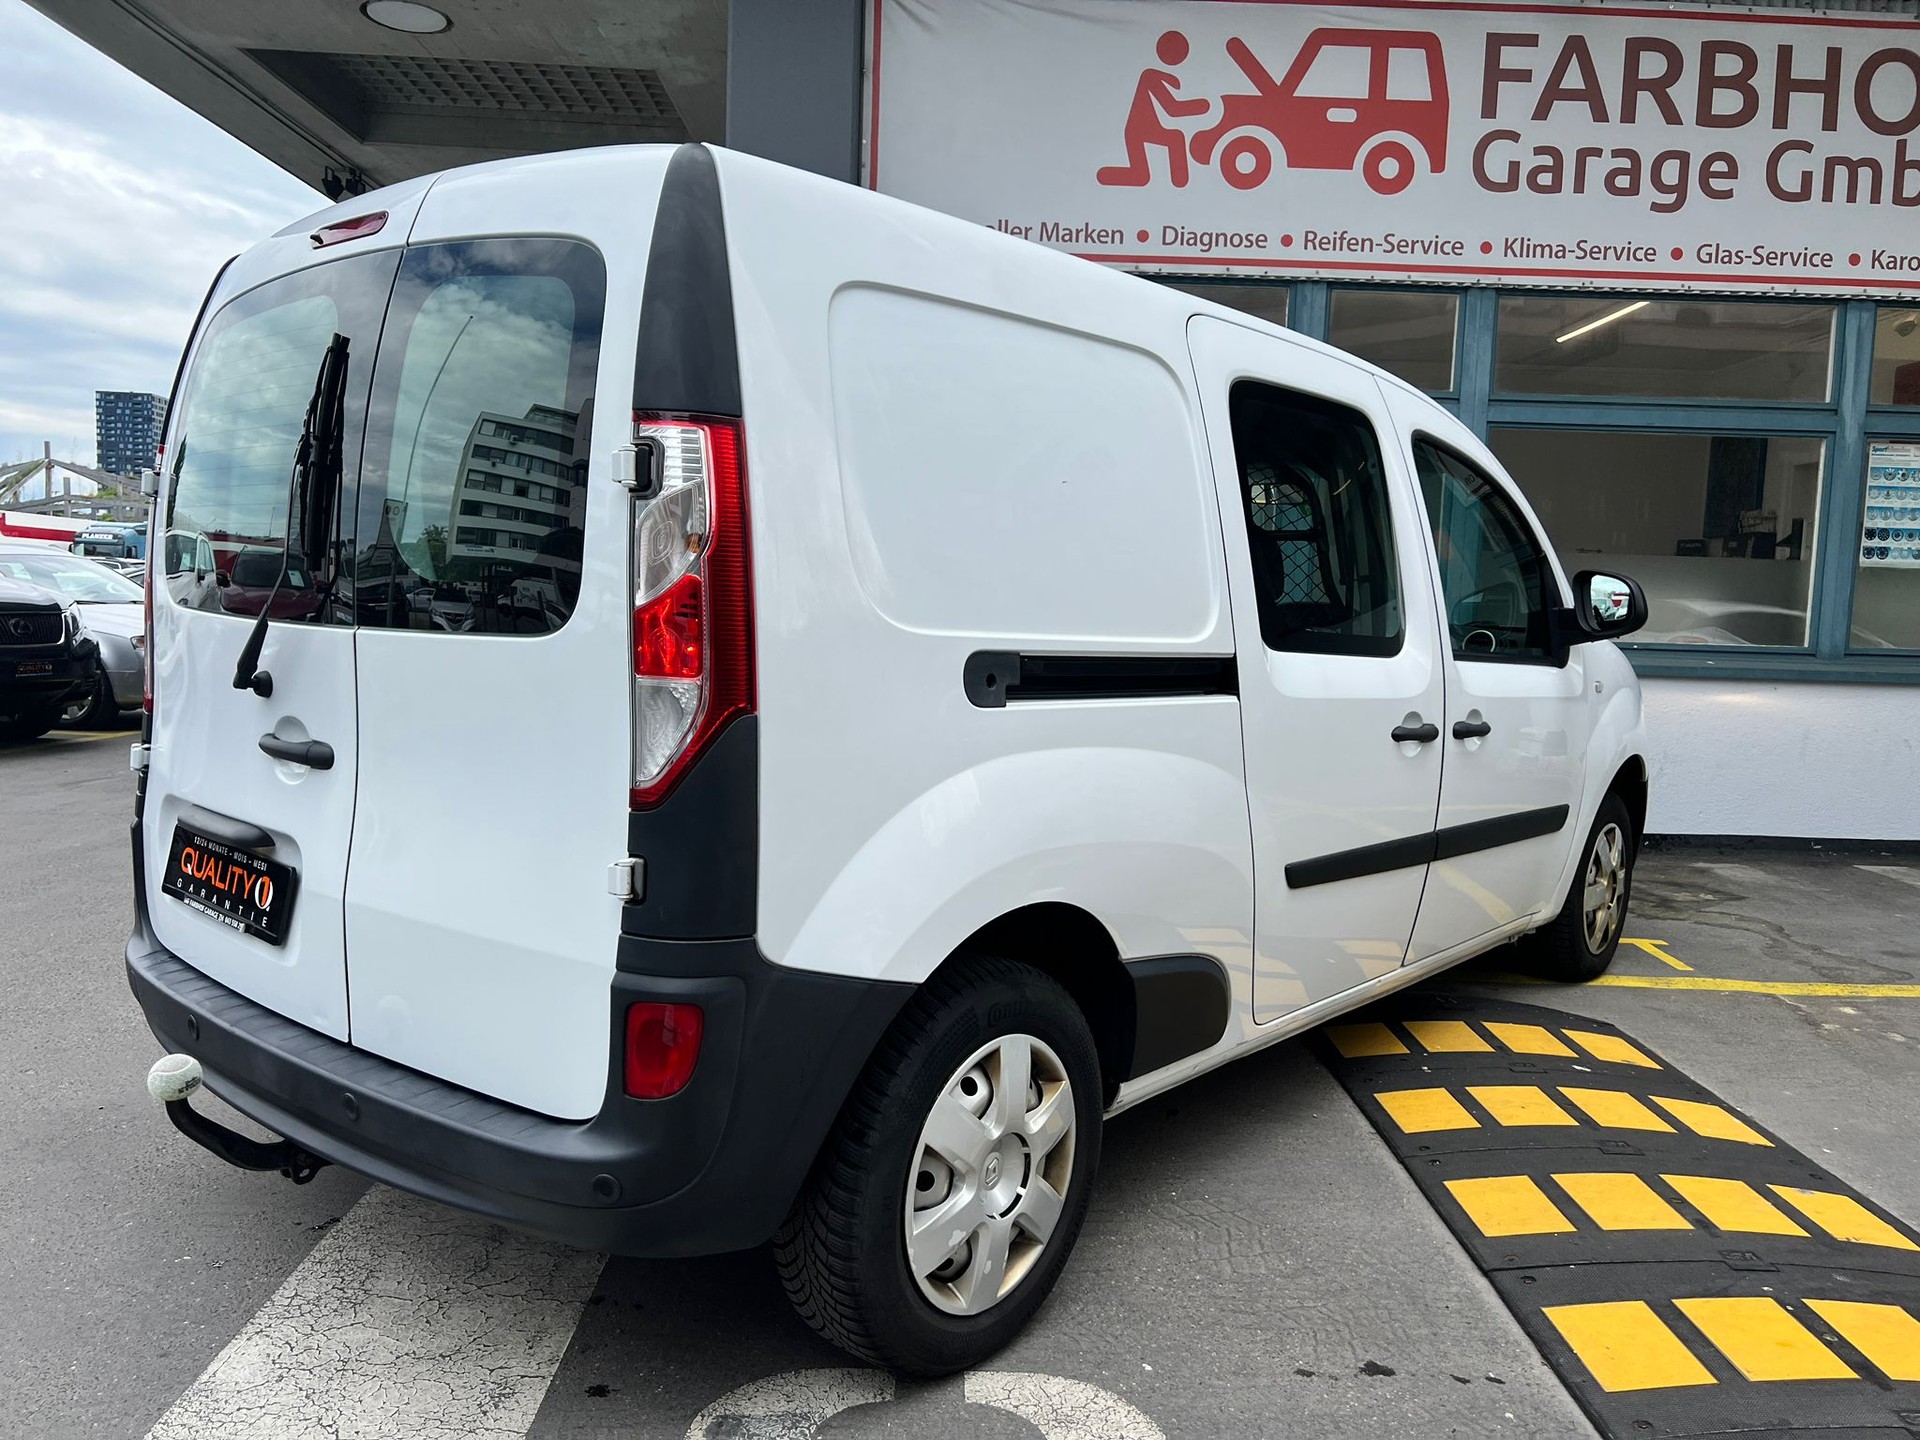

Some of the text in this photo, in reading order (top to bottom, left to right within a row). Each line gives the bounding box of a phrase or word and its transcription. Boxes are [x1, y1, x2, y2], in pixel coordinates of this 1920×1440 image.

[1472, 129, 1739, 214] Garage
[1039, 221, 1124, 245] Marken
[1162, 225, 1268, 253] Diagnose
[1303, 230, 1465, 256] Reifen-Service
[1504, 236, 1657, 263] Klima-Service
[1696, 242, 1834, 269] Glas-Service
[176, 878, 268, 927] GARANTIE
